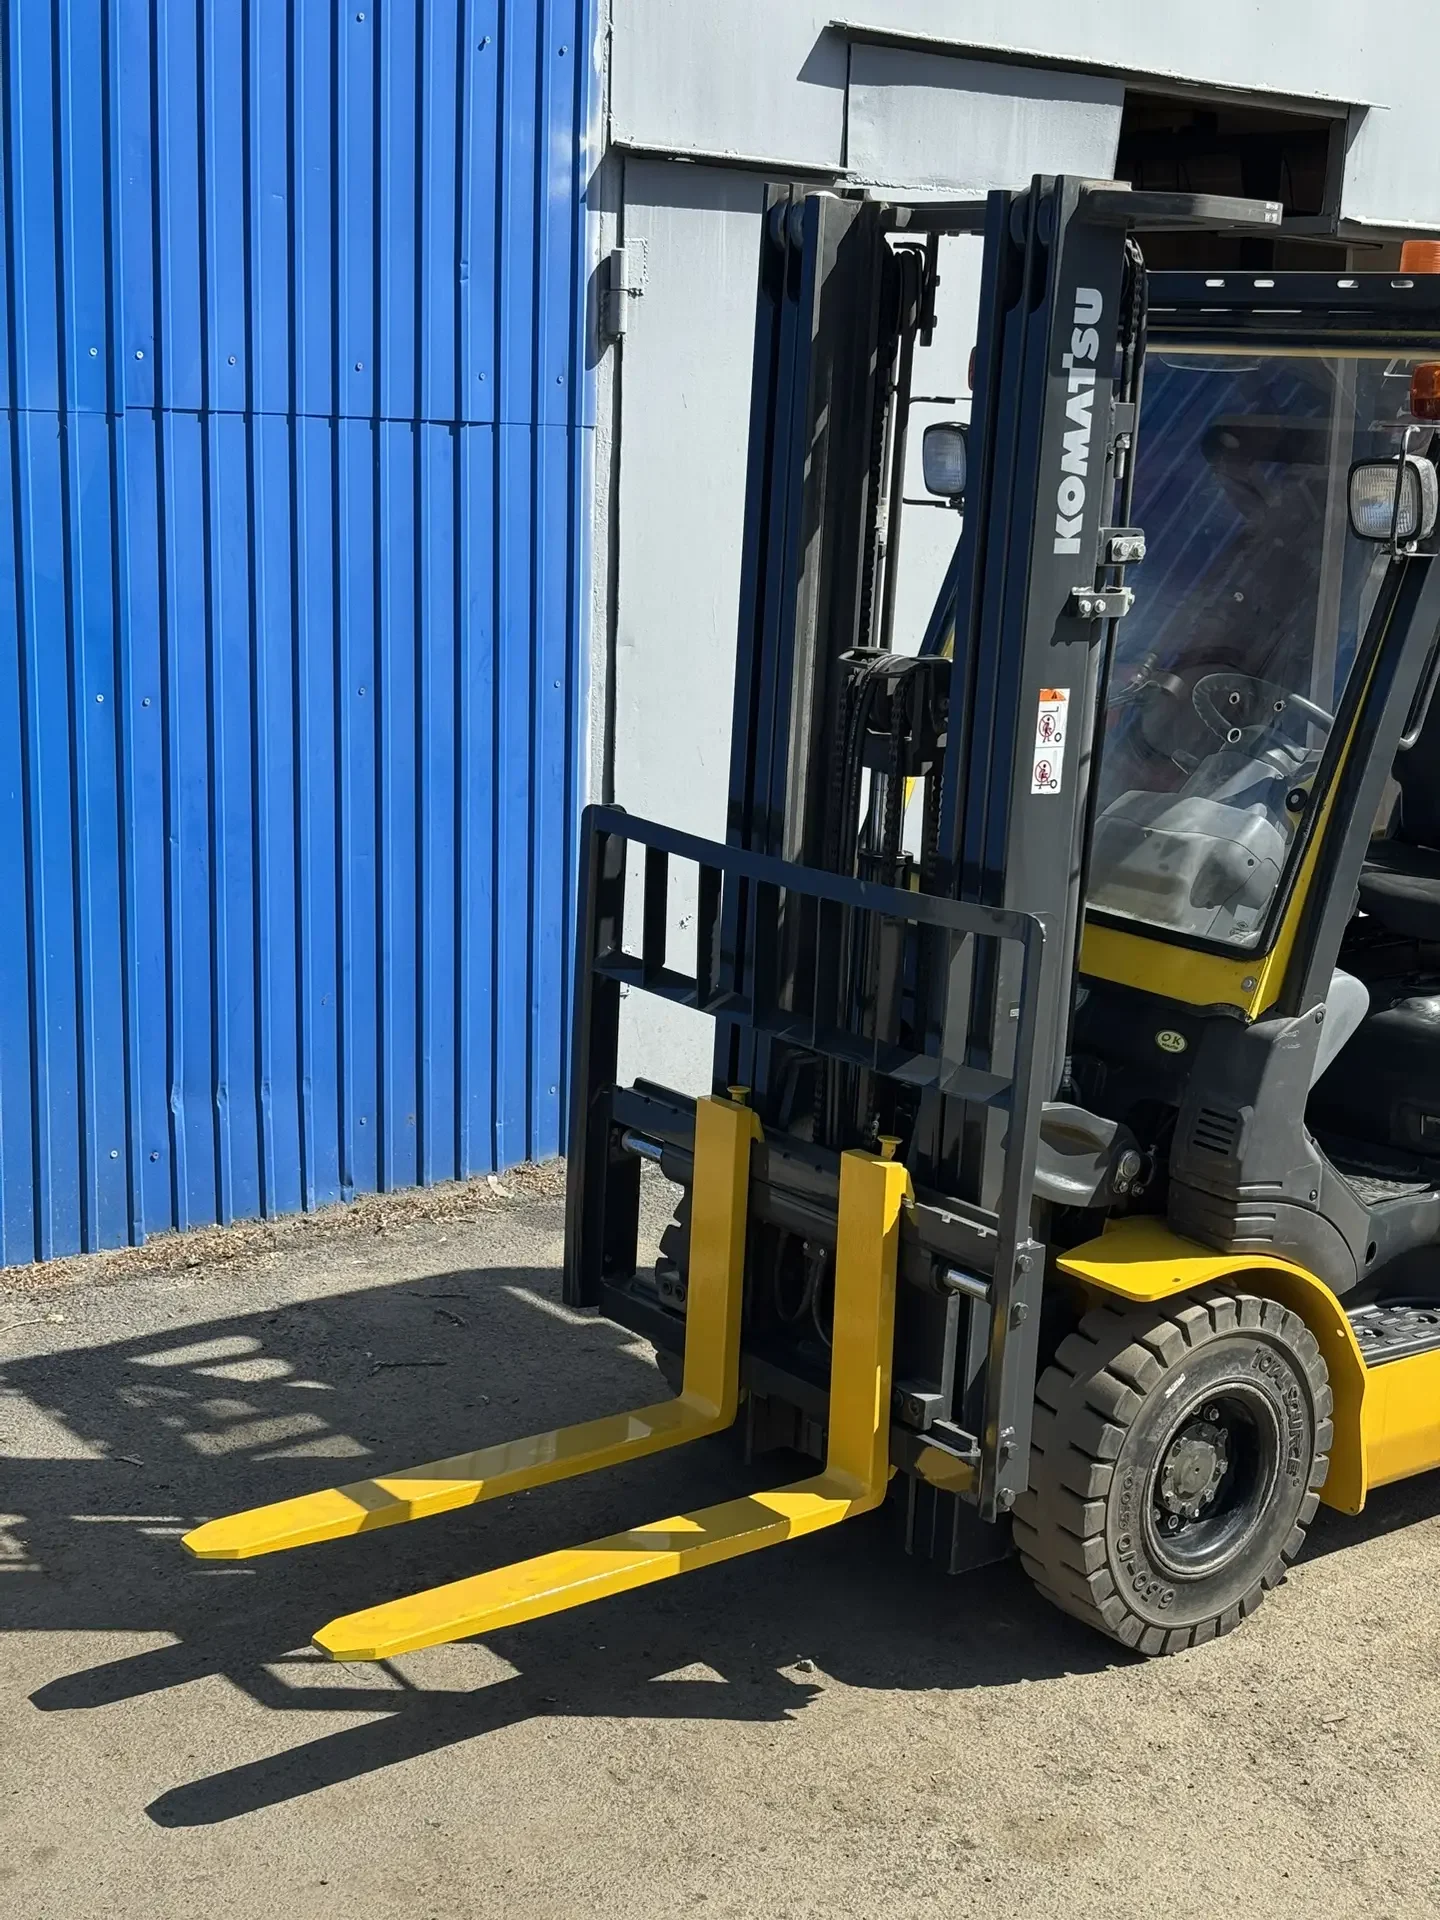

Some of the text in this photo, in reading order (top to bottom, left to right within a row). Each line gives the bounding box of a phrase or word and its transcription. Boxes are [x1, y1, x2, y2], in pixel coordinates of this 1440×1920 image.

[1053, 287, 1103, 554] KOMATSU
[1161, 1033, 1181, 1046] OK
[1282, 1384, 1303, 1477] SOURCE
